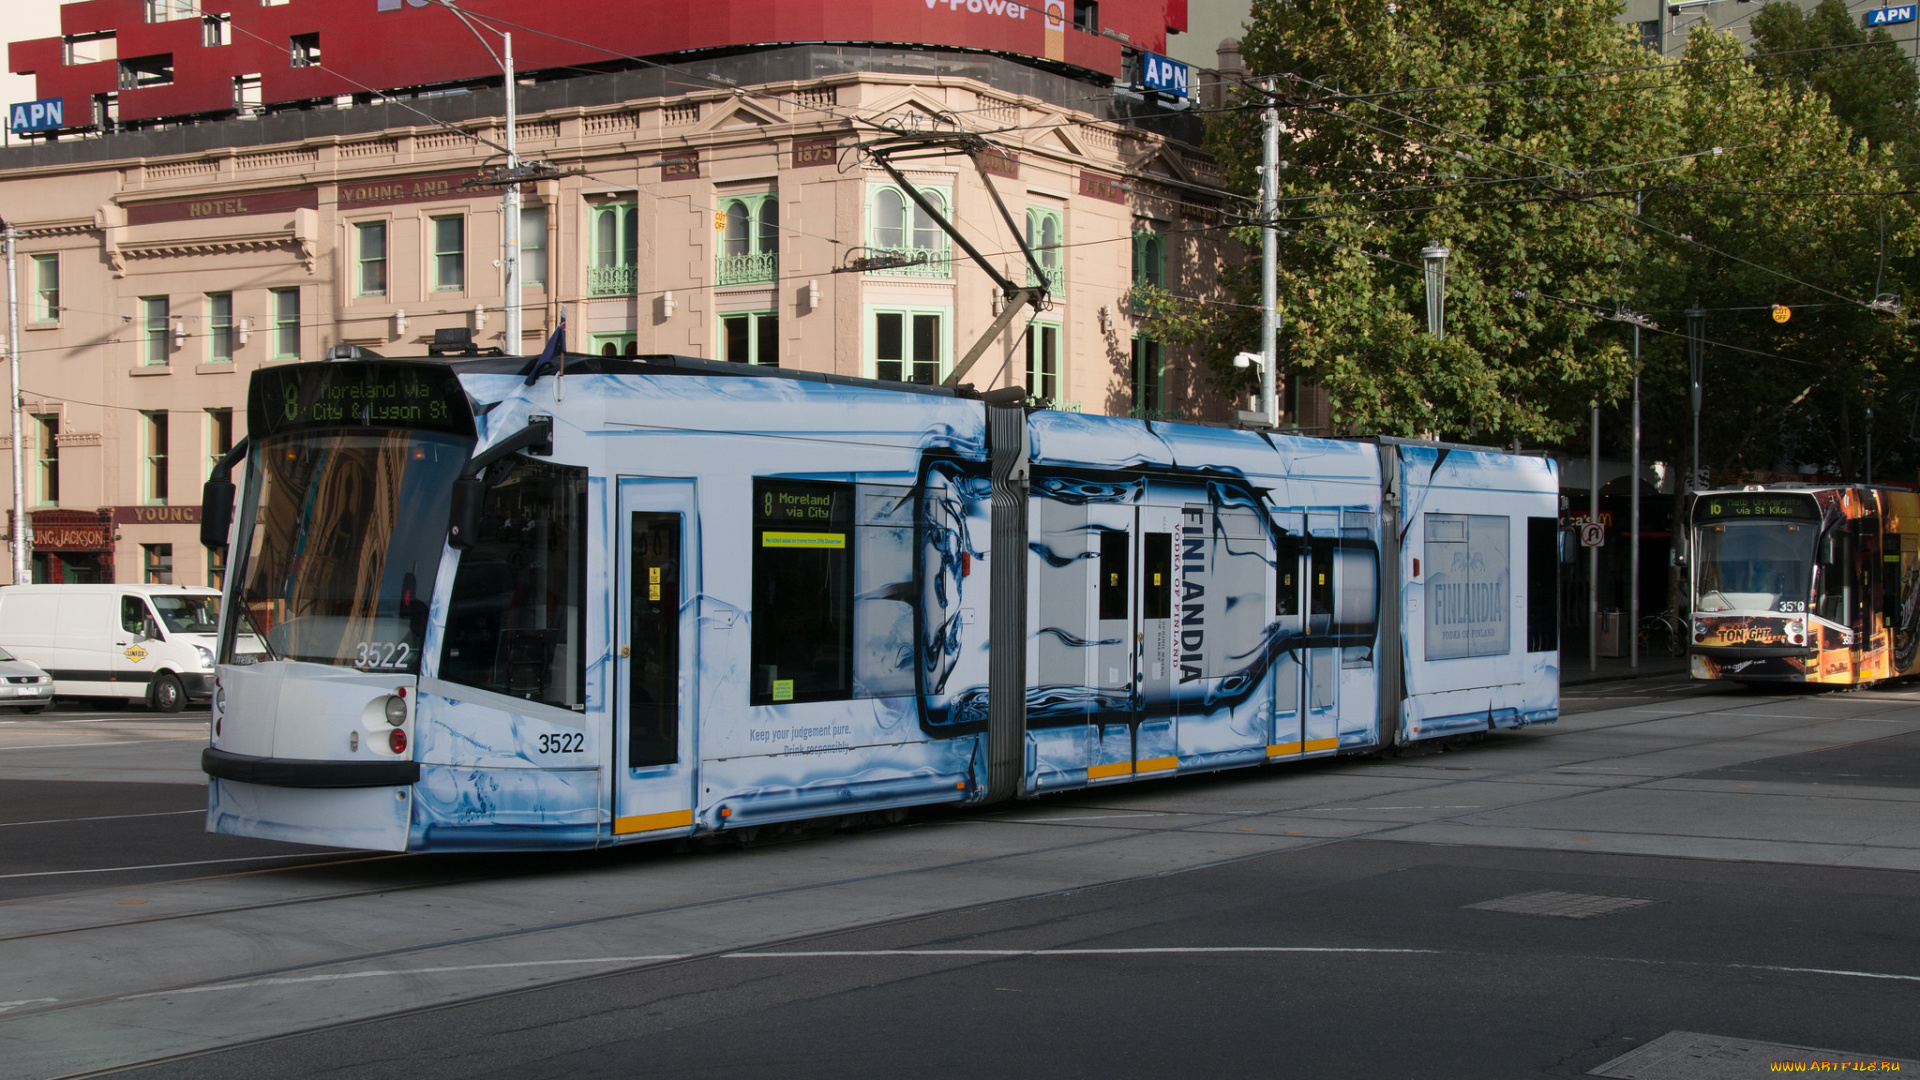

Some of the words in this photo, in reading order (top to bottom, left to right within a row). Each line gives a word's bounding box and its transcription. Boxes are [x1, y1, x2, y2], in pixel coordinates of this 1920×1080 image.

[1874, 7, 1910, 24] APN
[1145, 57, 1187, 93] APN
[12, 101, 63, 130] APN
[797, 143, 832, 163] 1875
[342, 184, 404, 204] YOUNG
[411, 180, 449, 199] AND
[1086, 176, 1118, 199] AND
[189, 199, 248, 217] HOTEL
[714, 211, 727, 222] CUT
[714, 222, 727, 231] OFF
[321, 380, 396, 399] Moreland
[404, 379, 430, 398] via
[285, 384, 299, 421] 8
[313, 403, 343, 420] City
[351, 402, 362, 418] &
[370, 401, 421, 420] Lygon
[429, 400, 448, 420] St
[764, 491, 773, 517] 8
[779, 492, 830, 506] Moreland
[134, 507, 194, 521] YOUNG
[786, 505, 804, 518] via
[808, 506, 829, 519] City
[1736, 507, 1750, 515] via
[1754, 506, 1766, 515] St
[1769, 506, 1793, 515] Kilda
[32, 529, 54, 546] UNG
[58, 528, 104, 548] JACKSON
[1174, 578, 1180, 597] OF
[1179, 507, 1205, 686] FINLANDIA
[1434, 582, 1502, 626] FINLANDIA
[1471, 628, 1496, 639] FINLAND
[354, 641, 410, 668] 3522
[538, 732, 585, 755] 3522
[749, 728, 770, 744] Keep
[772, 728, 789, 743] your
[791, 725, 831, 742] judgement
[832, 725, 852, 739] pure.
[784, 744, 805, 758] Drink
[806, 741, 852, 758] responsibly.
